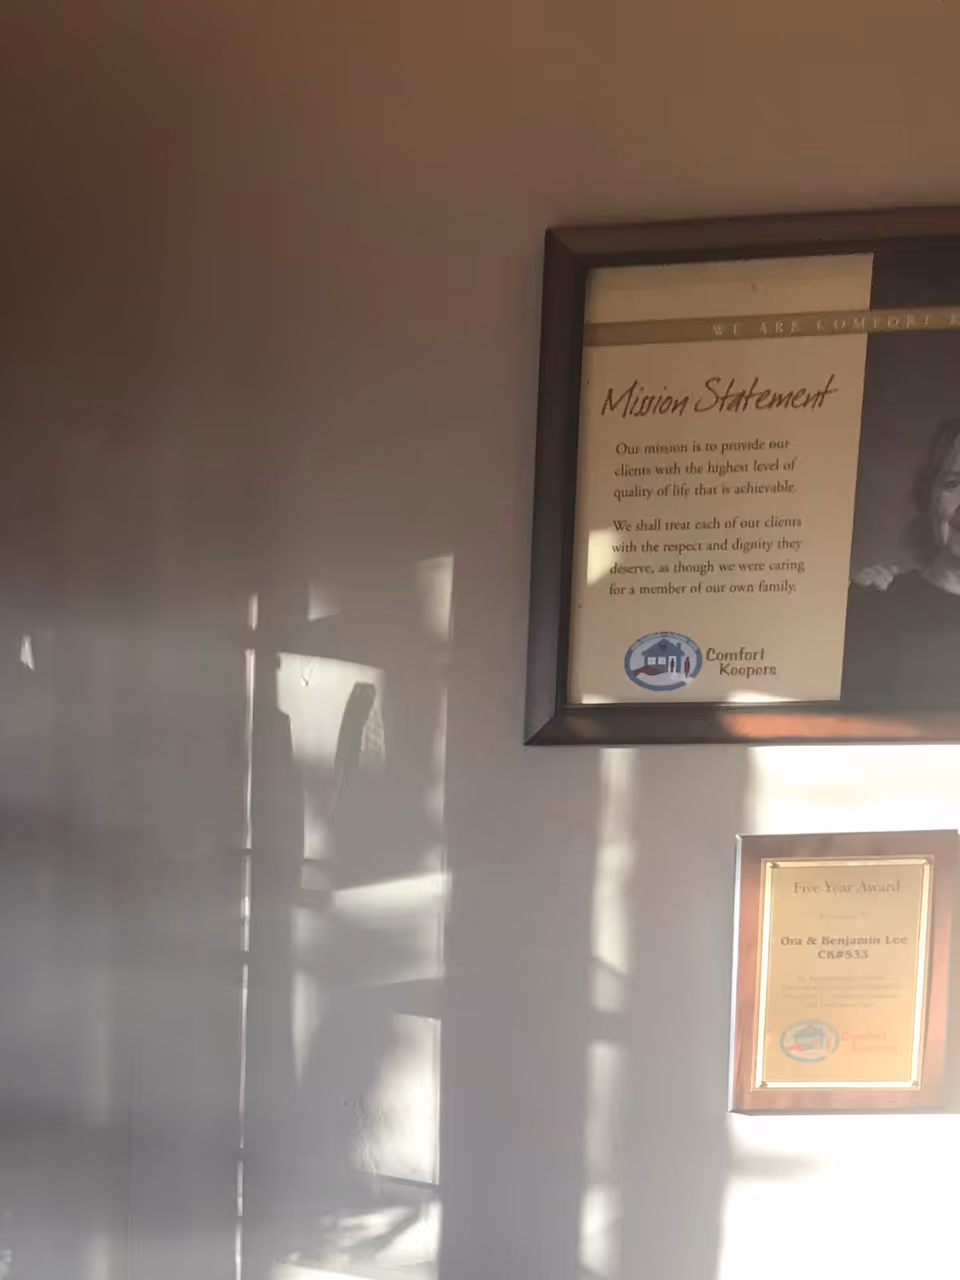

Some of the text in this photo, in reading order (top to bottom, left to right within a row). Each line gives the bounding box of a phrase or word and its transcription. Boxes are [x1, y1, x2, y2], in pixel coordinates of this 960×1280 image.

[816, 314, 931, 332] COMFORT
[601, 374, 838, 418] Mission Statement
[615, 438, 790, 455] Our mission is to provide our
[614, 457, 797, 477] clients with the highest level of
[613, 480, 797, 501] quality of life that is achievable.
[613, 515, 802, 532] We shall treat each of our clients
[612, 536, 802, 555] with the respect and dignity they
[610, 559, 805, 576] deserve, as though we were caring
[609, 579, 796, 595] for a member of our own family.
[706, 646, 765, 661] Comfort
[719, 663, 777, 679] Keepers
[780, 936, 907, 946] Ora & Benjamin Lee
